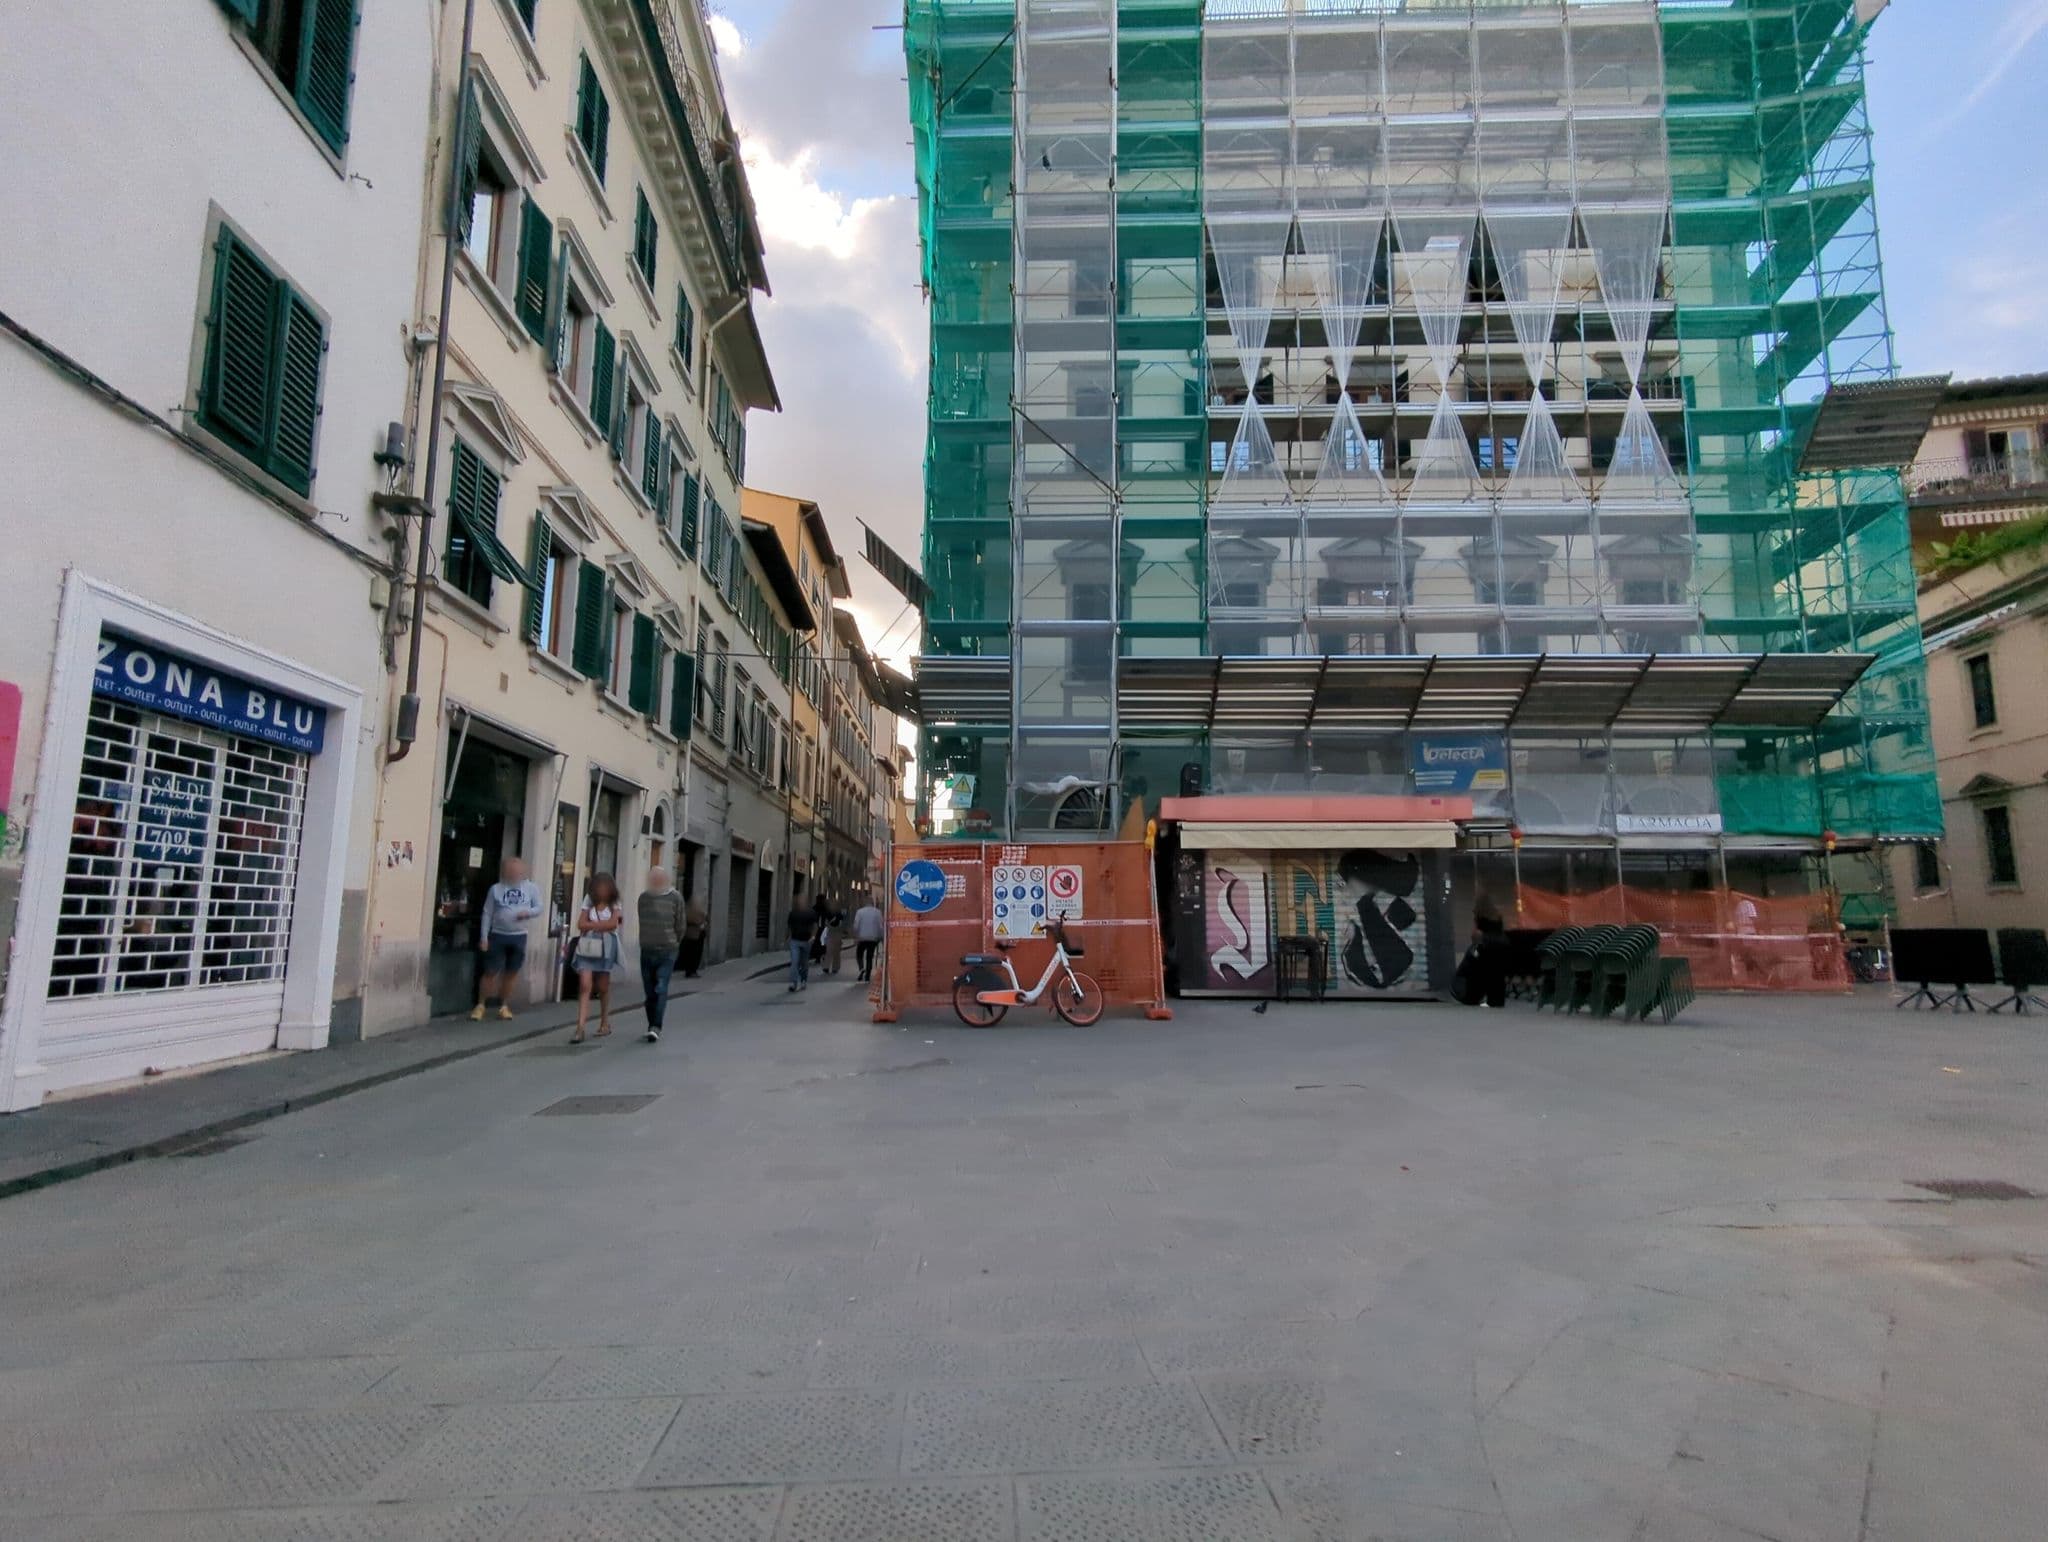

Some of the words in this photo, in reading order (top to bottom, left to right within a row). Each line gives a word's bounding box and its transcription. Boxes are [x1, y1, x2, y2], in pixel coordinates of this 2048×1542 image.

[95, 638, 225, 708] ZONA
[247, 690, 313, 734] BLU
[94, 678, 115, 691] TLET
[125, 686, 156, 704] OUTLET
[164, 698, 193, 714] OUTLET
[200, 709, 227, 724] OUTLET
[234, 719, 258, 734] OUTLET
[264, 728, 287, 741] OUTLET
[292, 736, 313, 748] OUTLET
[152, 776, 204, 802] SALDI
[151, 830, 192, 855] 70%
